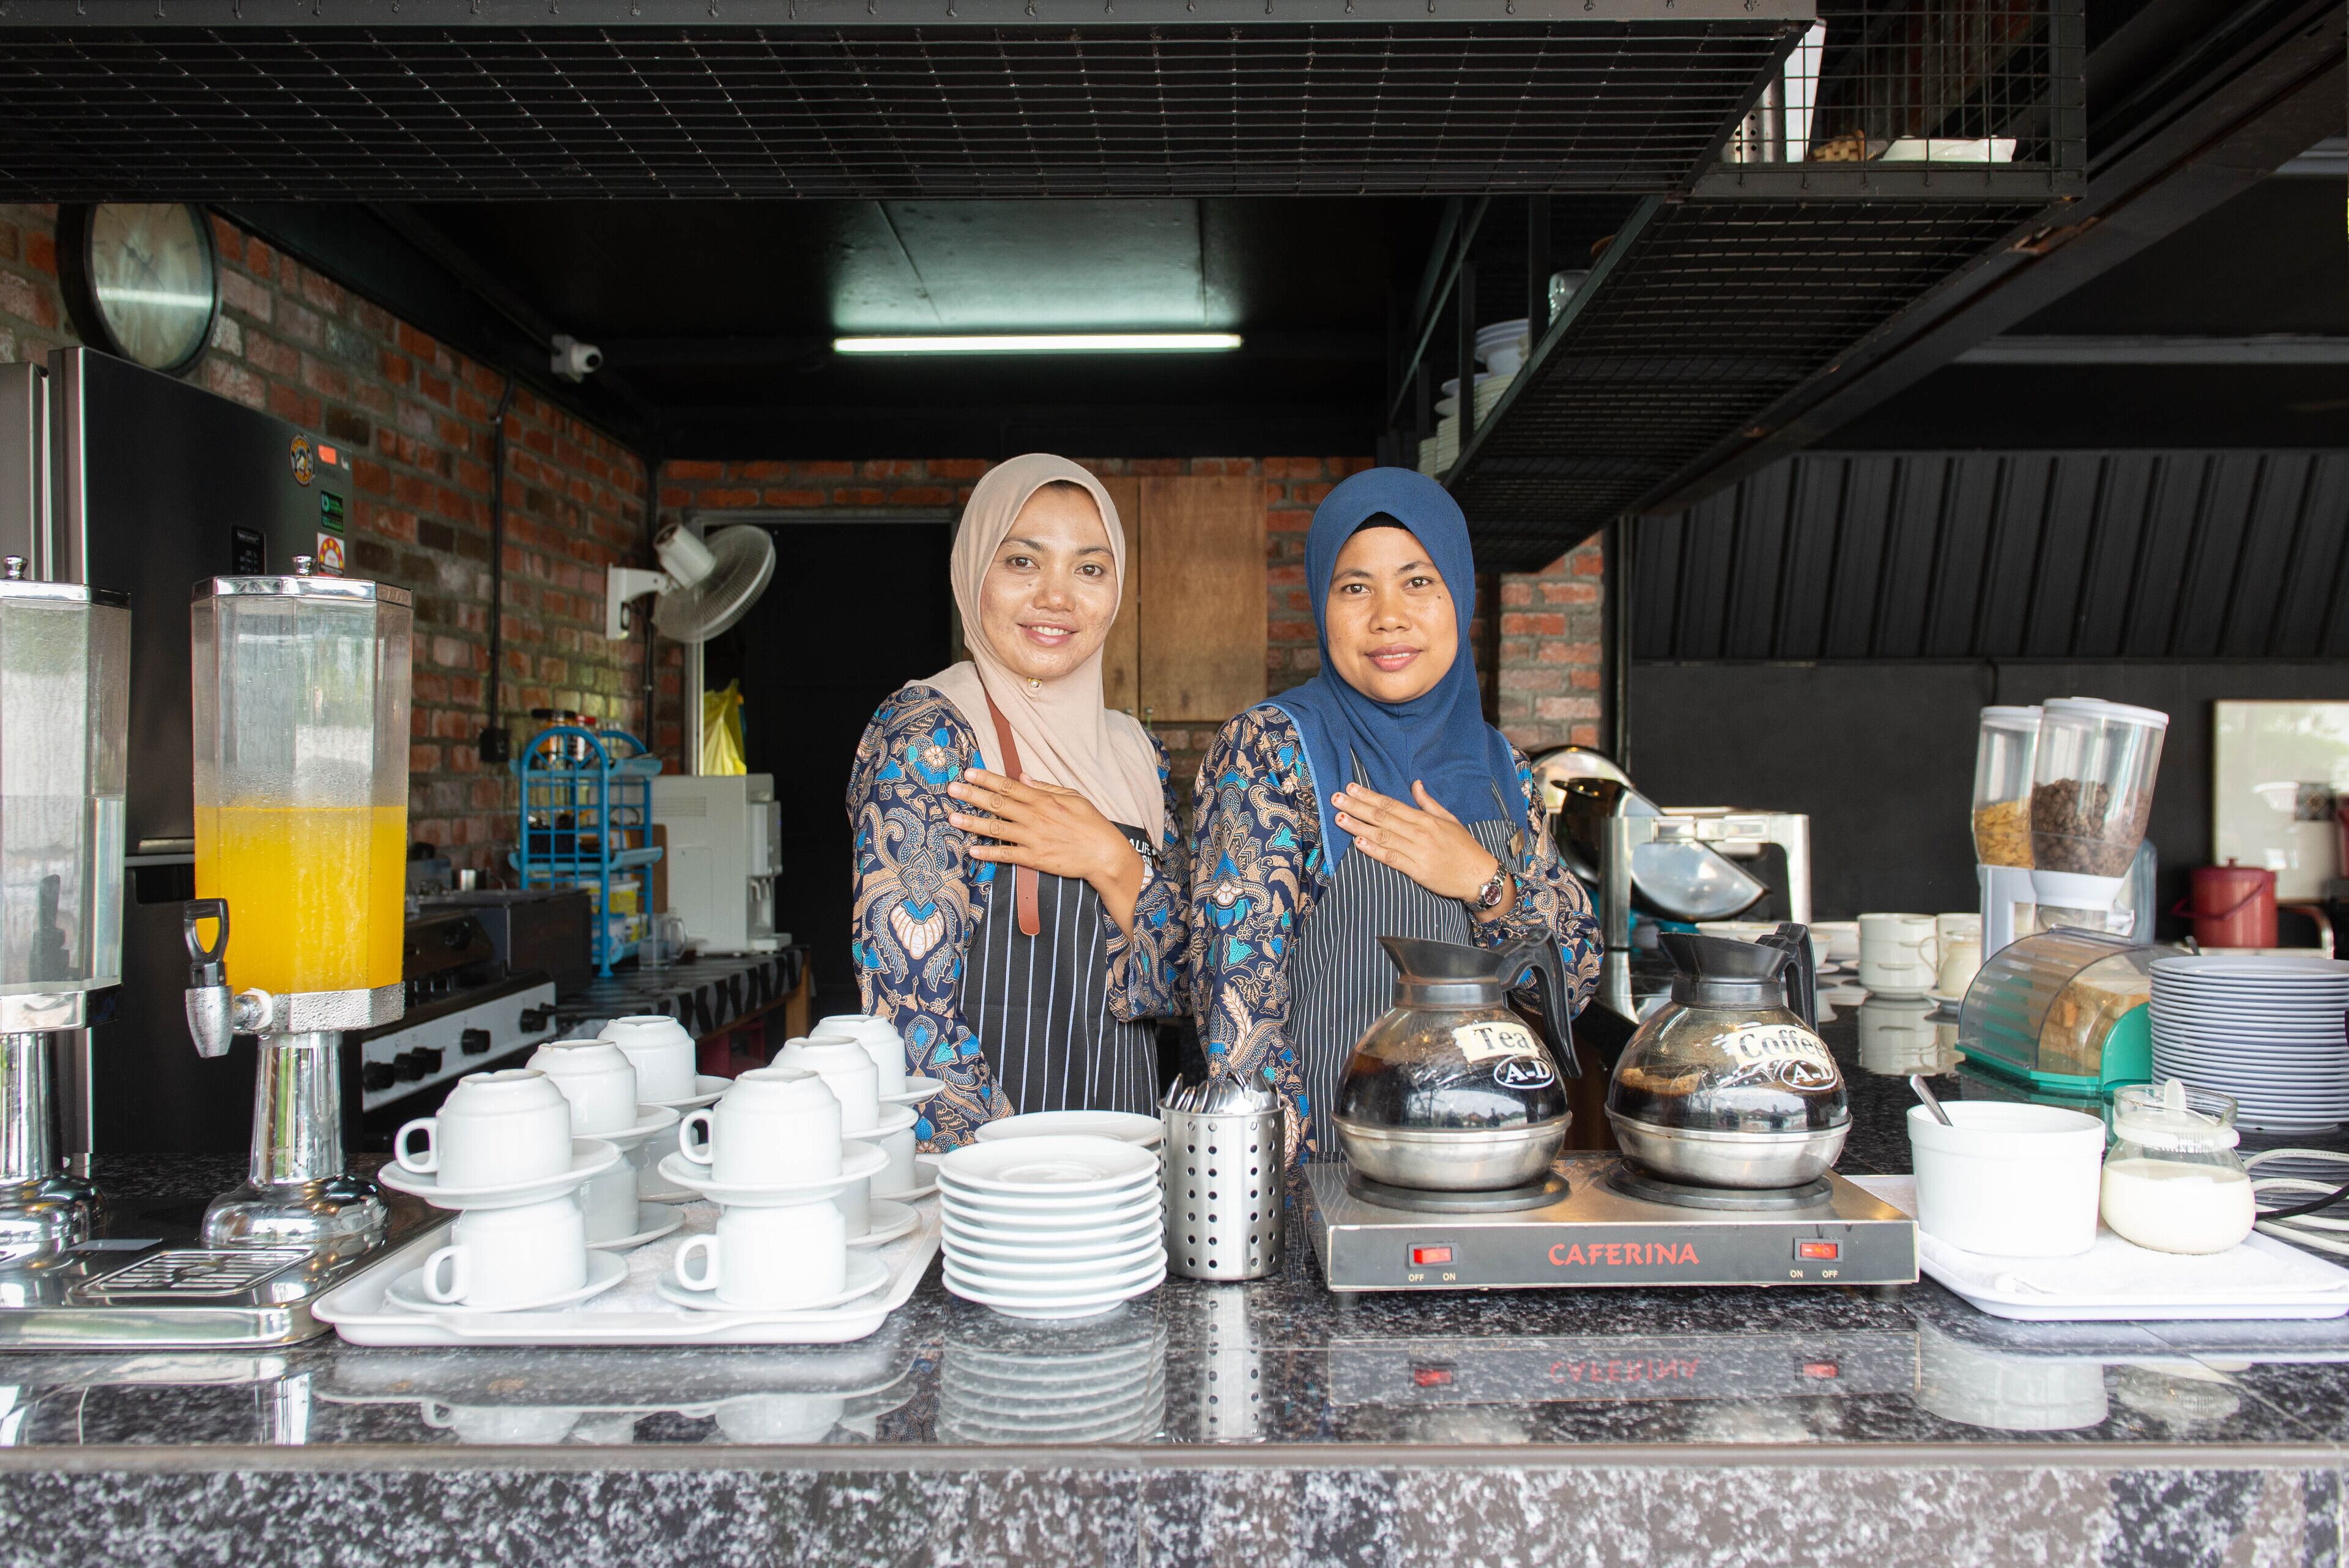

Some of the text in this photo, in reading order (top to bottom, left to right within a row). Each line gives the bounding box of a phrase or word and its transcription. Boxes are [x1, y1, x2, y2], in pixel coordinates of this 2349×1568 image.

[1472, 1027, 1531, 1051] Tea
[1739, 1029, 1827, 1059] Coffee
[1504, 1060, 1551, 1083] A-D
[1548, 1243, 1700, 1266] CAFERINA
[1408, 1272, 1456, 1282] OFF ON
[1789, 1268, 1839, 1278] ON OFF
